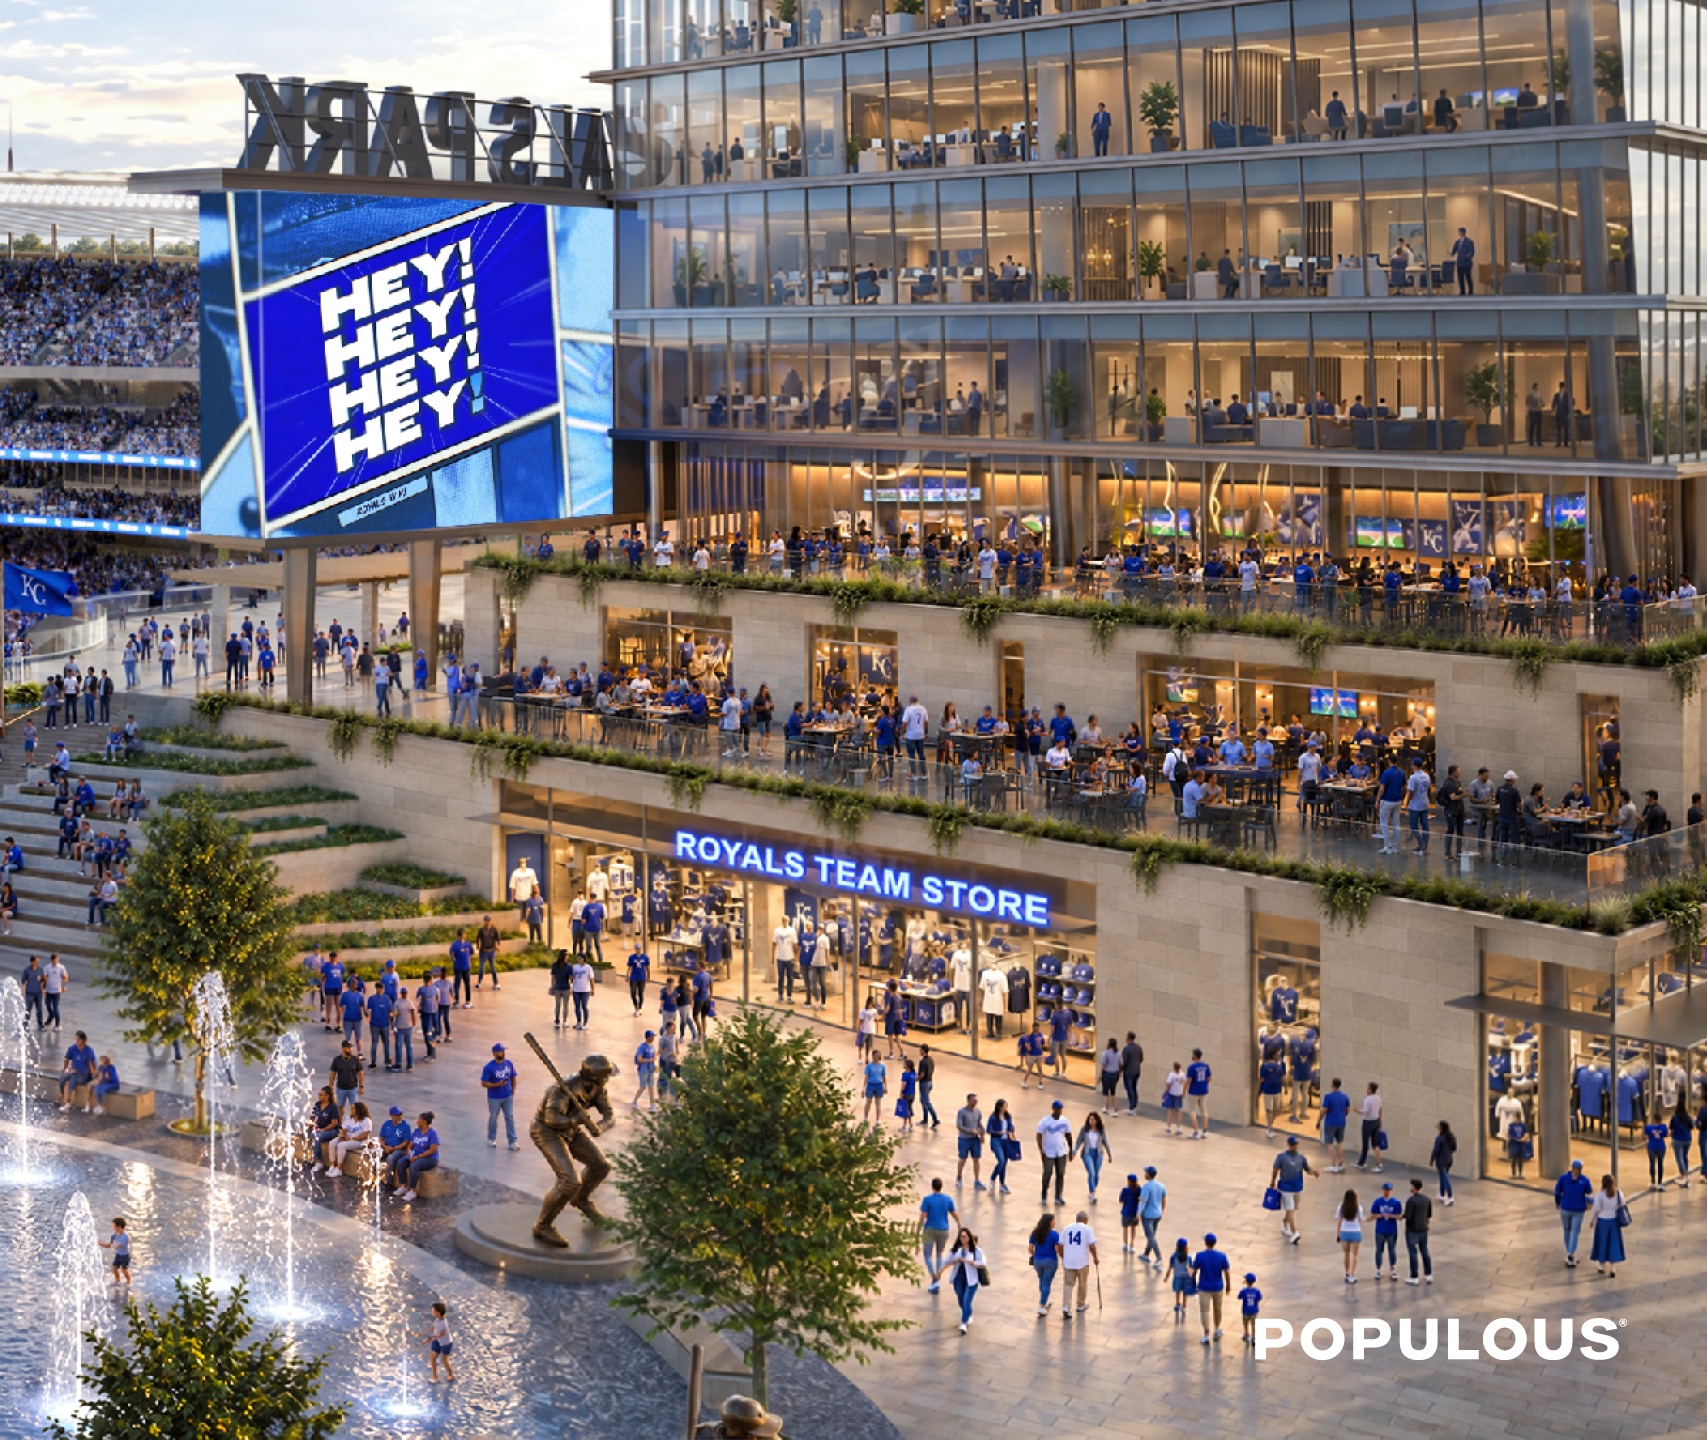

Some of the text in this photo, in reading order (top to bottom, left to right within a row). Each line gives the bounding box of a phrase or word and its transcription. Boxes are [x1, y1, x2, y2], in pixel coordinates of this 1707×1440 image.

[320, 237, 473, 334] HEY!
[324, 283, 477, 382] HEY!
[329, 327, 480, 428] HEY!
[333, 371, 484, 474] HEY!
[21, 574, 47, 606] KC
[676, 830, 1048, 927] ROYALS TEAM STORE
[1068, 1231, 1082, 1246] 14
